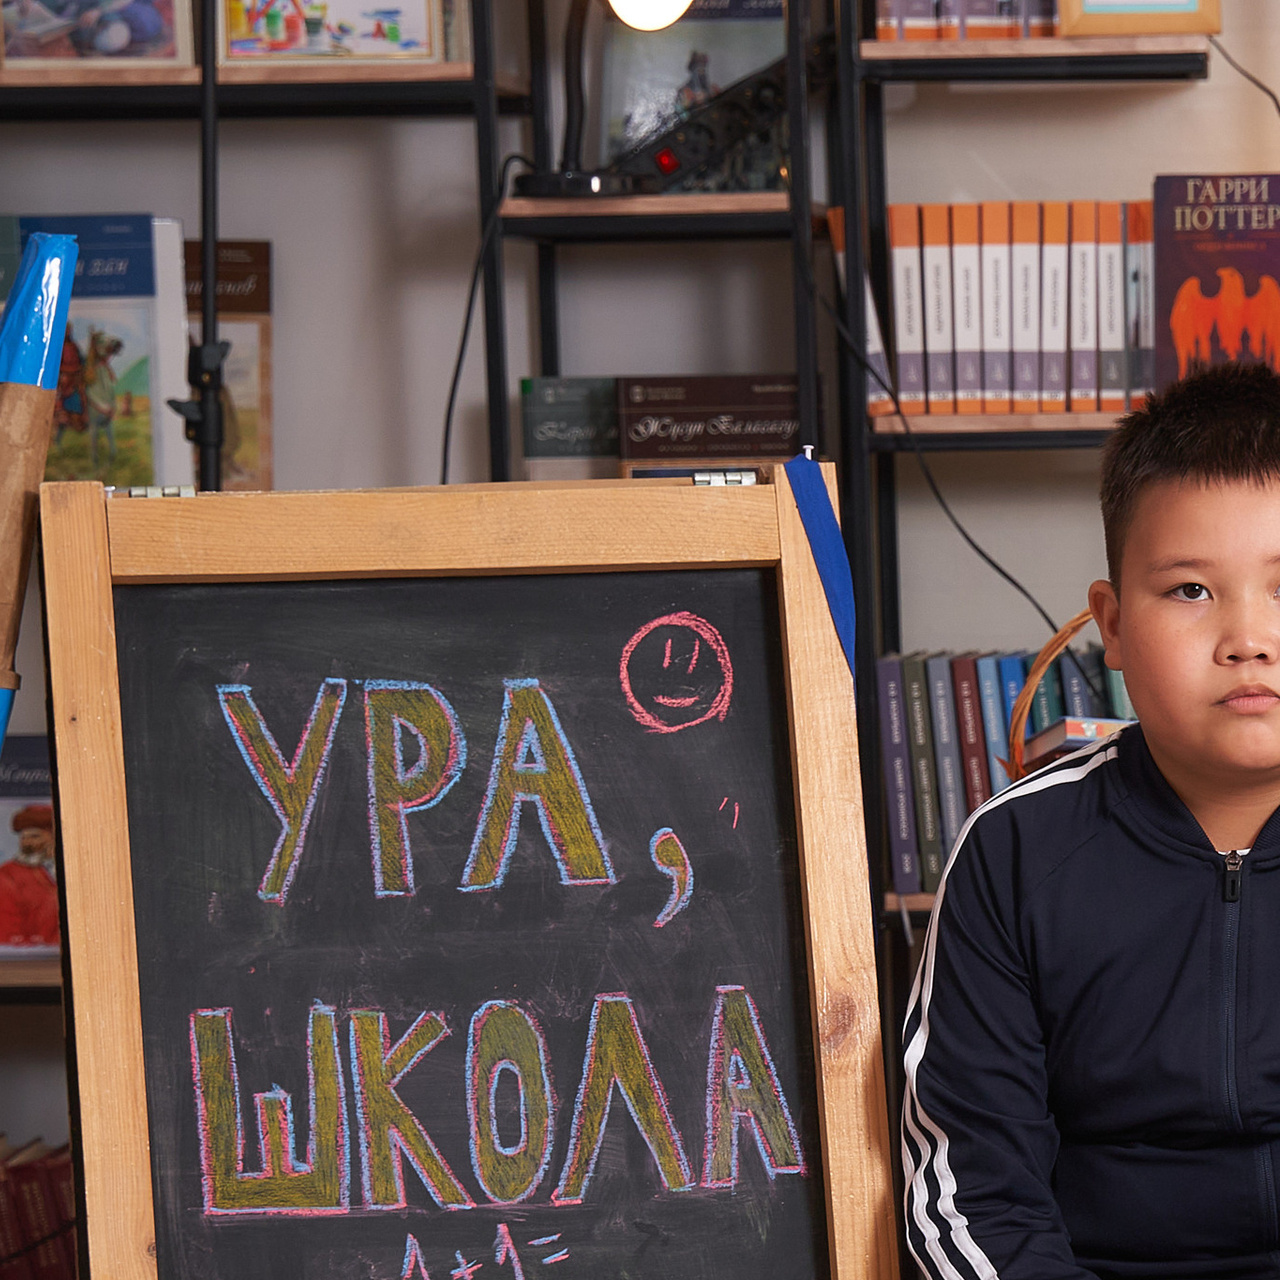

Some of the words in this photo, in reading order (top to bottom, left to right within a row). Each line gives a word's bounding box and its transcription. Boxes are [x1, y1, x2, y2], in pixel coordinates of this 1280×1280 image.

[1185, 177, 1270, 204] ГАРРИ
[216, 676, 694, 928] УРА,
[189, 984, 807, 1216] ШКОЛА
